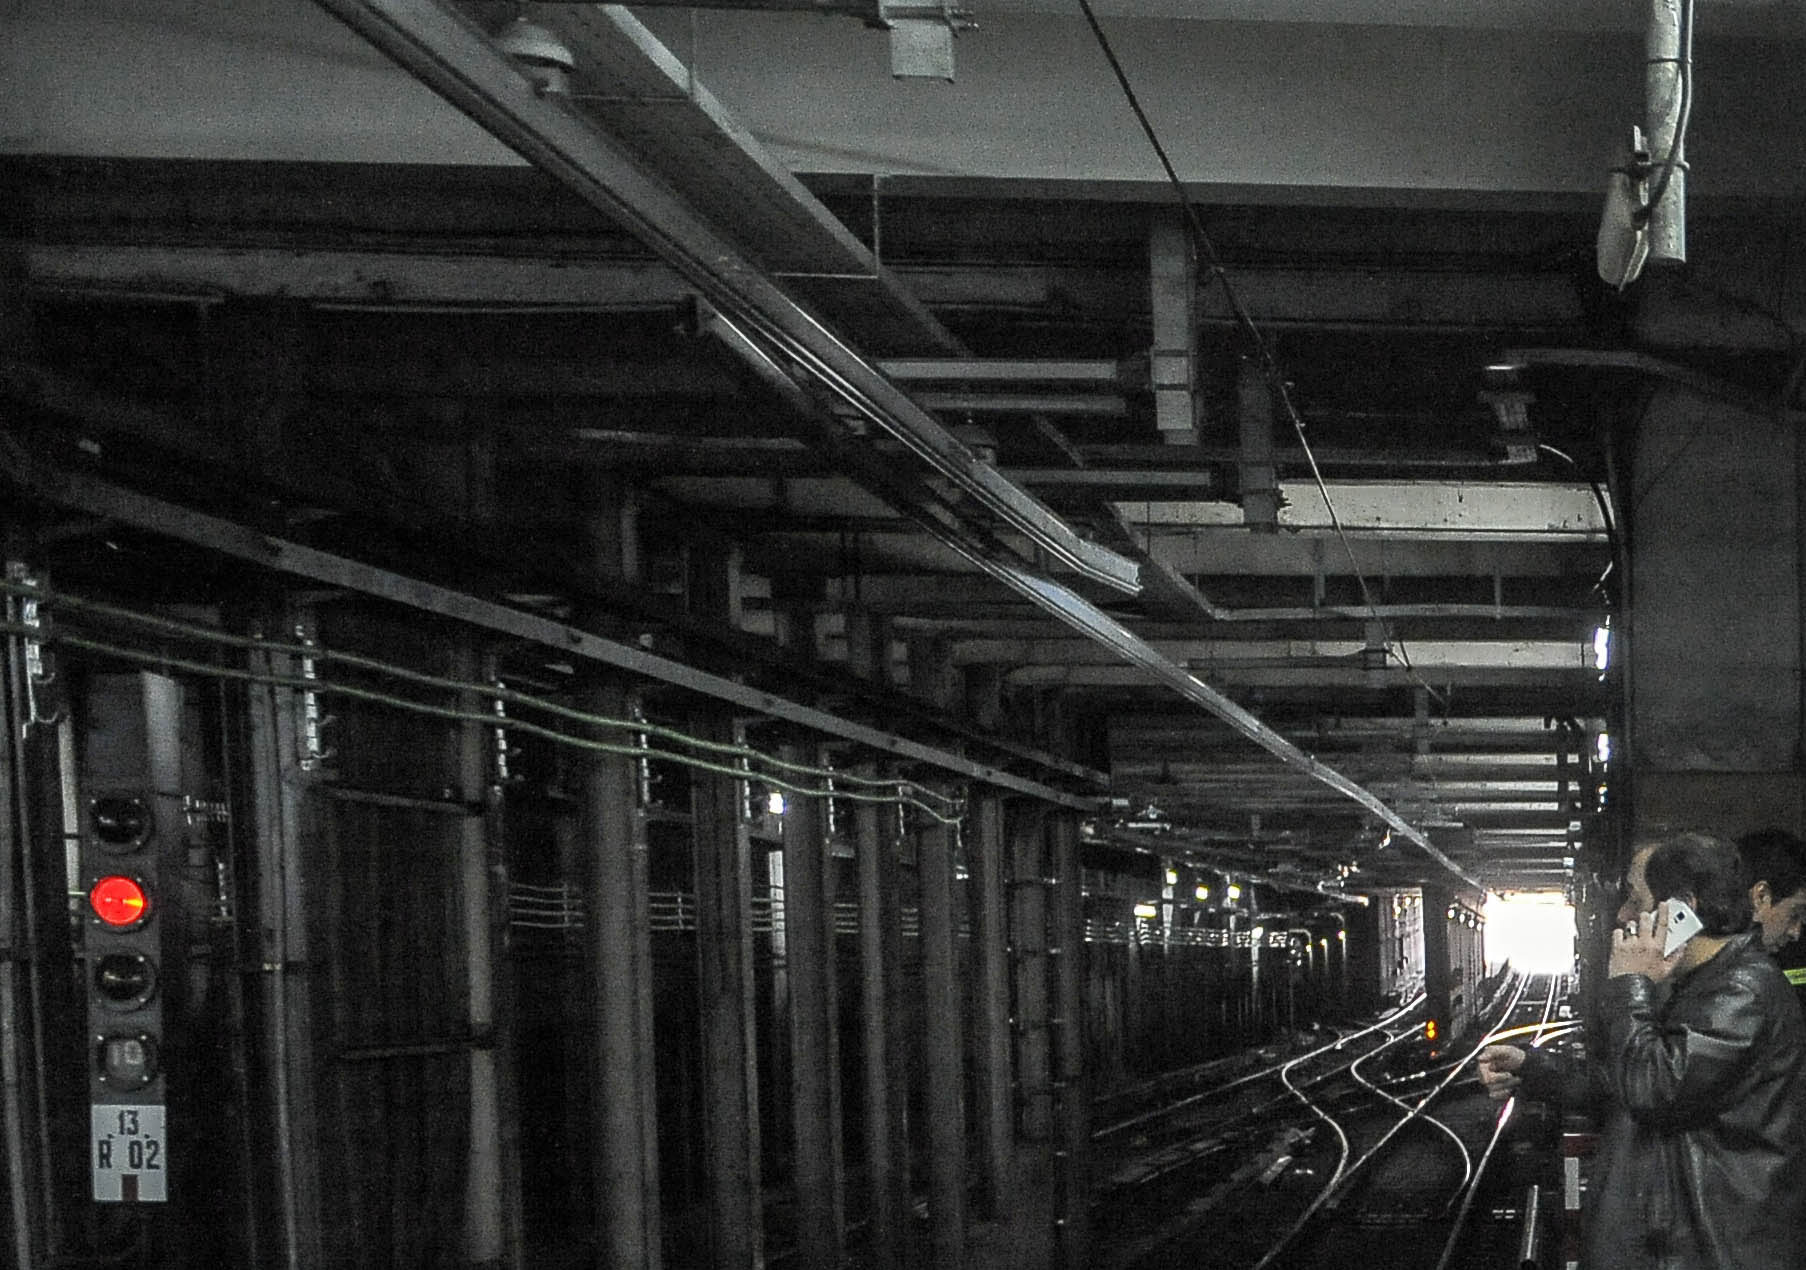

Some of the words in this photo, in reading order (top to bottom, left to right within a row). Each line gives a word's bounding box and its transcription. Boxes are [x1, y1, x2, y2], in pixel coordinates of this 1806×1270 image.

[119, 1110, 139, 1135] 13
[98, 1140, 112, 1168] R
[129, 1141, 160, 1169] 02
